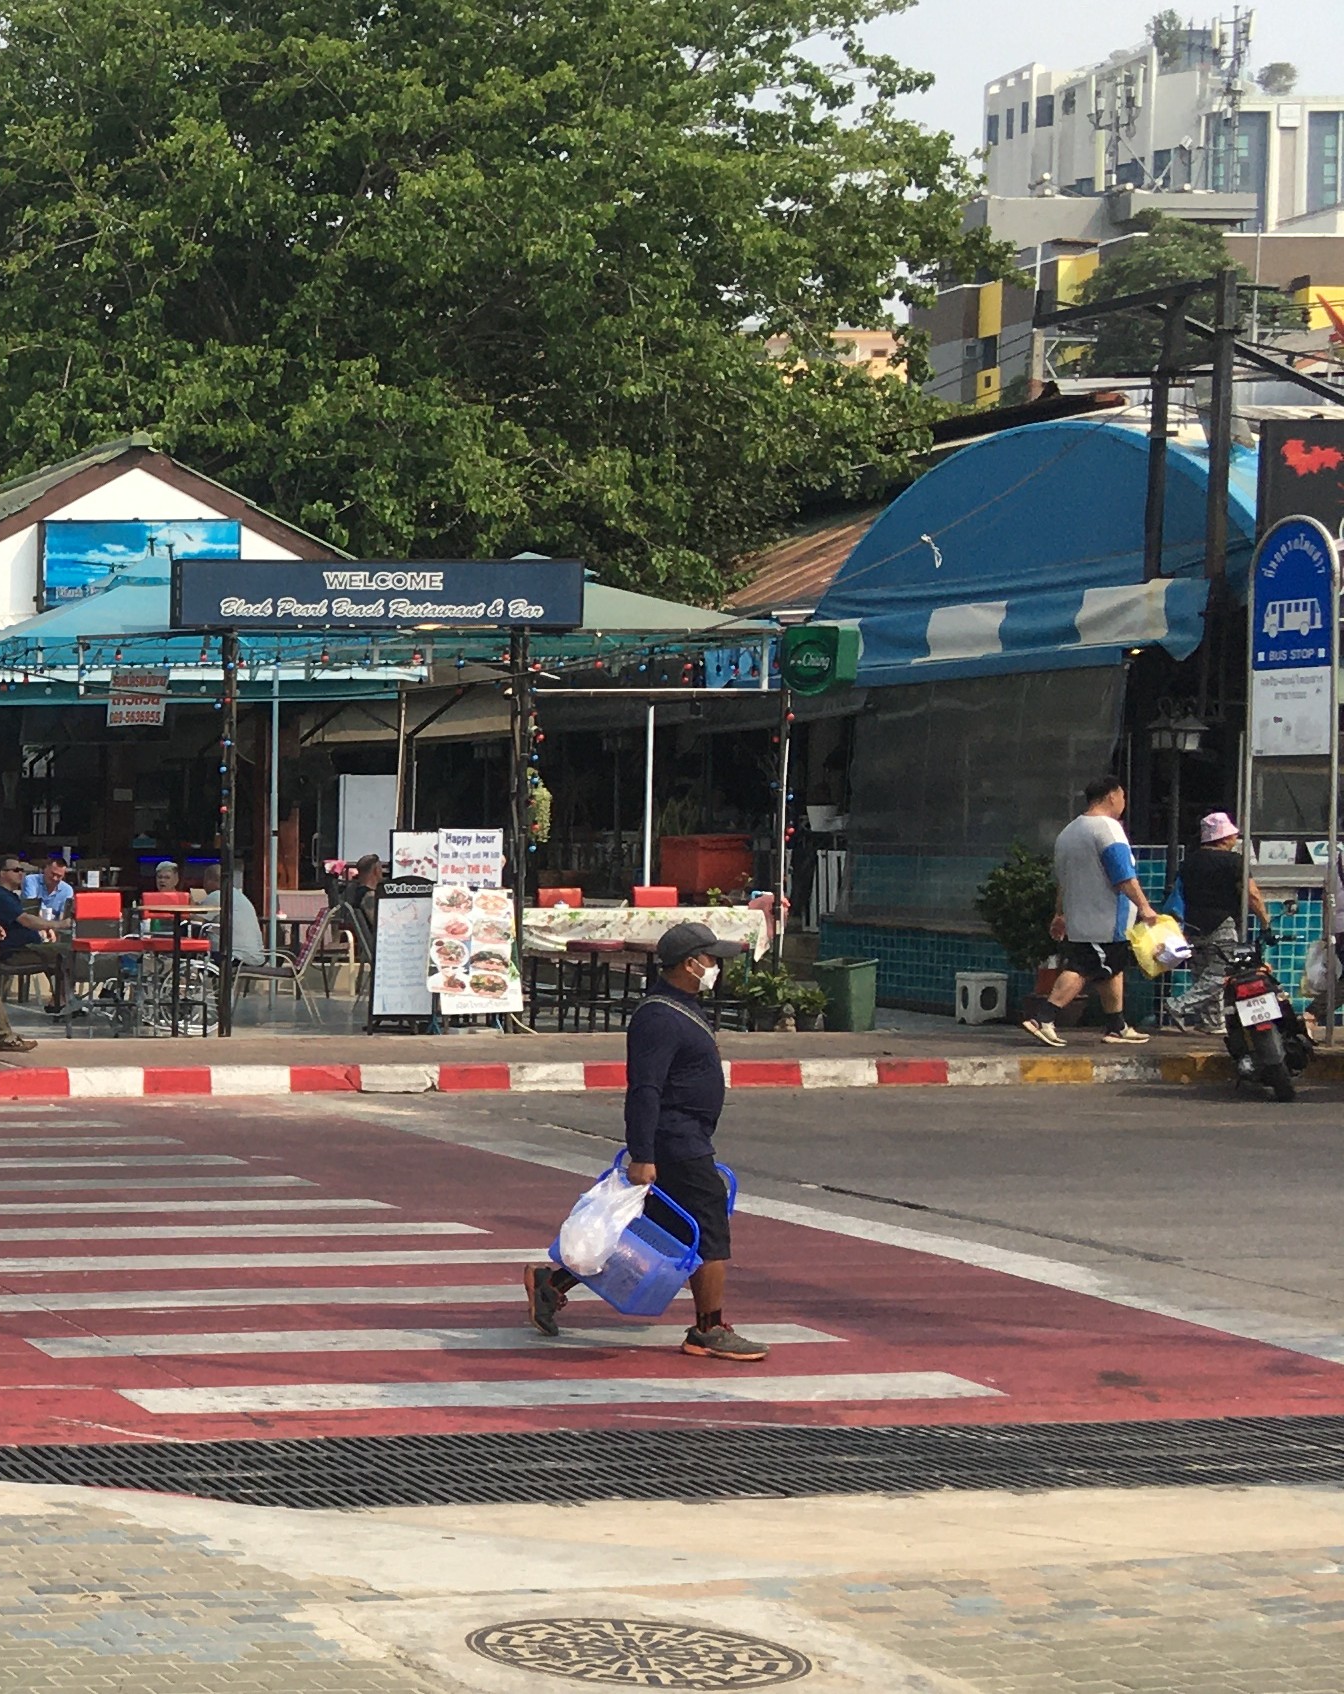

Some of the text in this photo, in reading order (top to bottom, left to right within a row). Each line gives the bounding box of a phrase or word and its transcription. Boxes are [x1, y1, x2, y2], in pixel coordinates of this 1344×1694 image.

[323, 571, 443, 590] WELCOME
[220, 598, 544, 619] Black Pearl Beach Restaurant & Bar
[1269, 648, 1315, 661] BUS STOP
[445, 833, 472, 845] Happy
[476, 833, 496, 843] hour
[384, 884, 432, 894] Welcome
